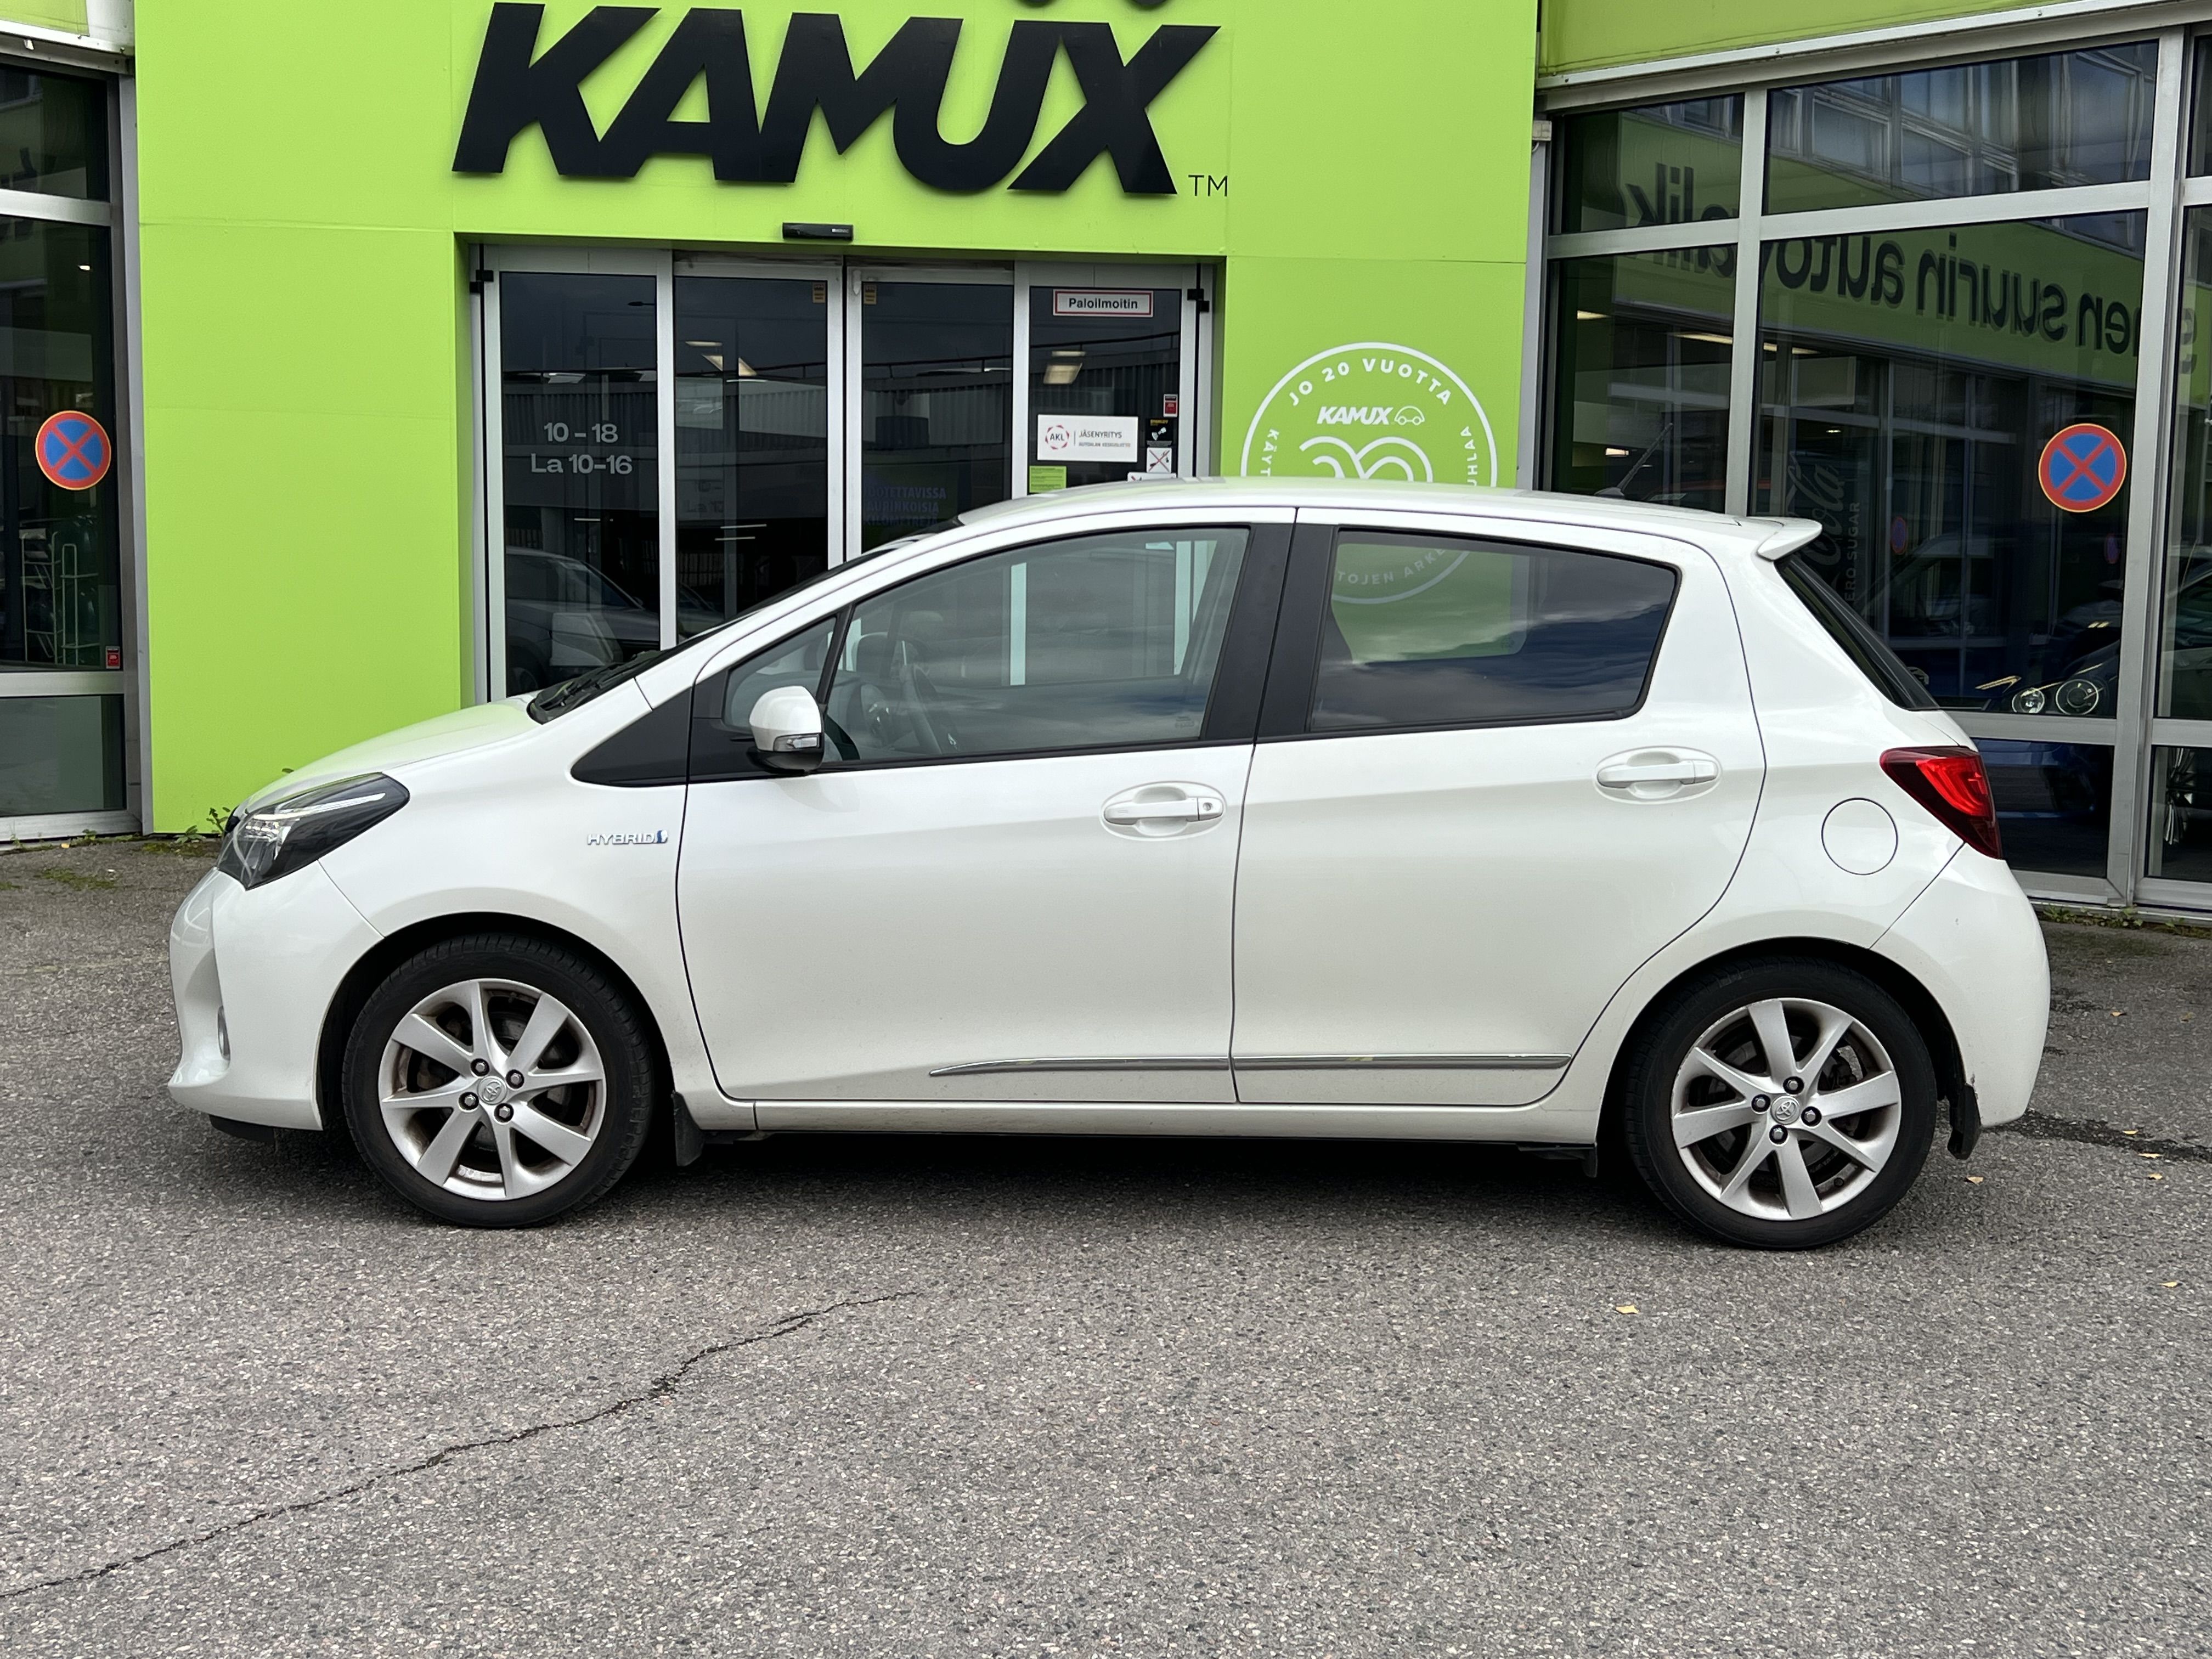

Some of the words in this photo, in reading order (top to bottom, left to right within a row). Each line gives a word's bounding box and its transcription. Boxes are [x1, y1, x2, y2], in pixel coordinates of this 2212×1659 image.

[452, 1, 1222, 196] KAMUX
[1188, 174, 1228, 196] TM
[1068, 297, 1138, 310] Paloilmoitin
[1289, 381, 1313, 406] JO
[1322, 362, 1350, 382] 20
[1362, 358, 1451, 405] VUOTTA
[1317, 406, 1394, 425] KAMUX
[543, 422, 569, 442] 10
[591, 423, 618, 443] 18
[1049, 433, 1065, 441] AKL
[531, 453, 563, 473] La
[1847, 502, 1860, 560] SUGAR
[587, 833, 656, 845] HYBRID
